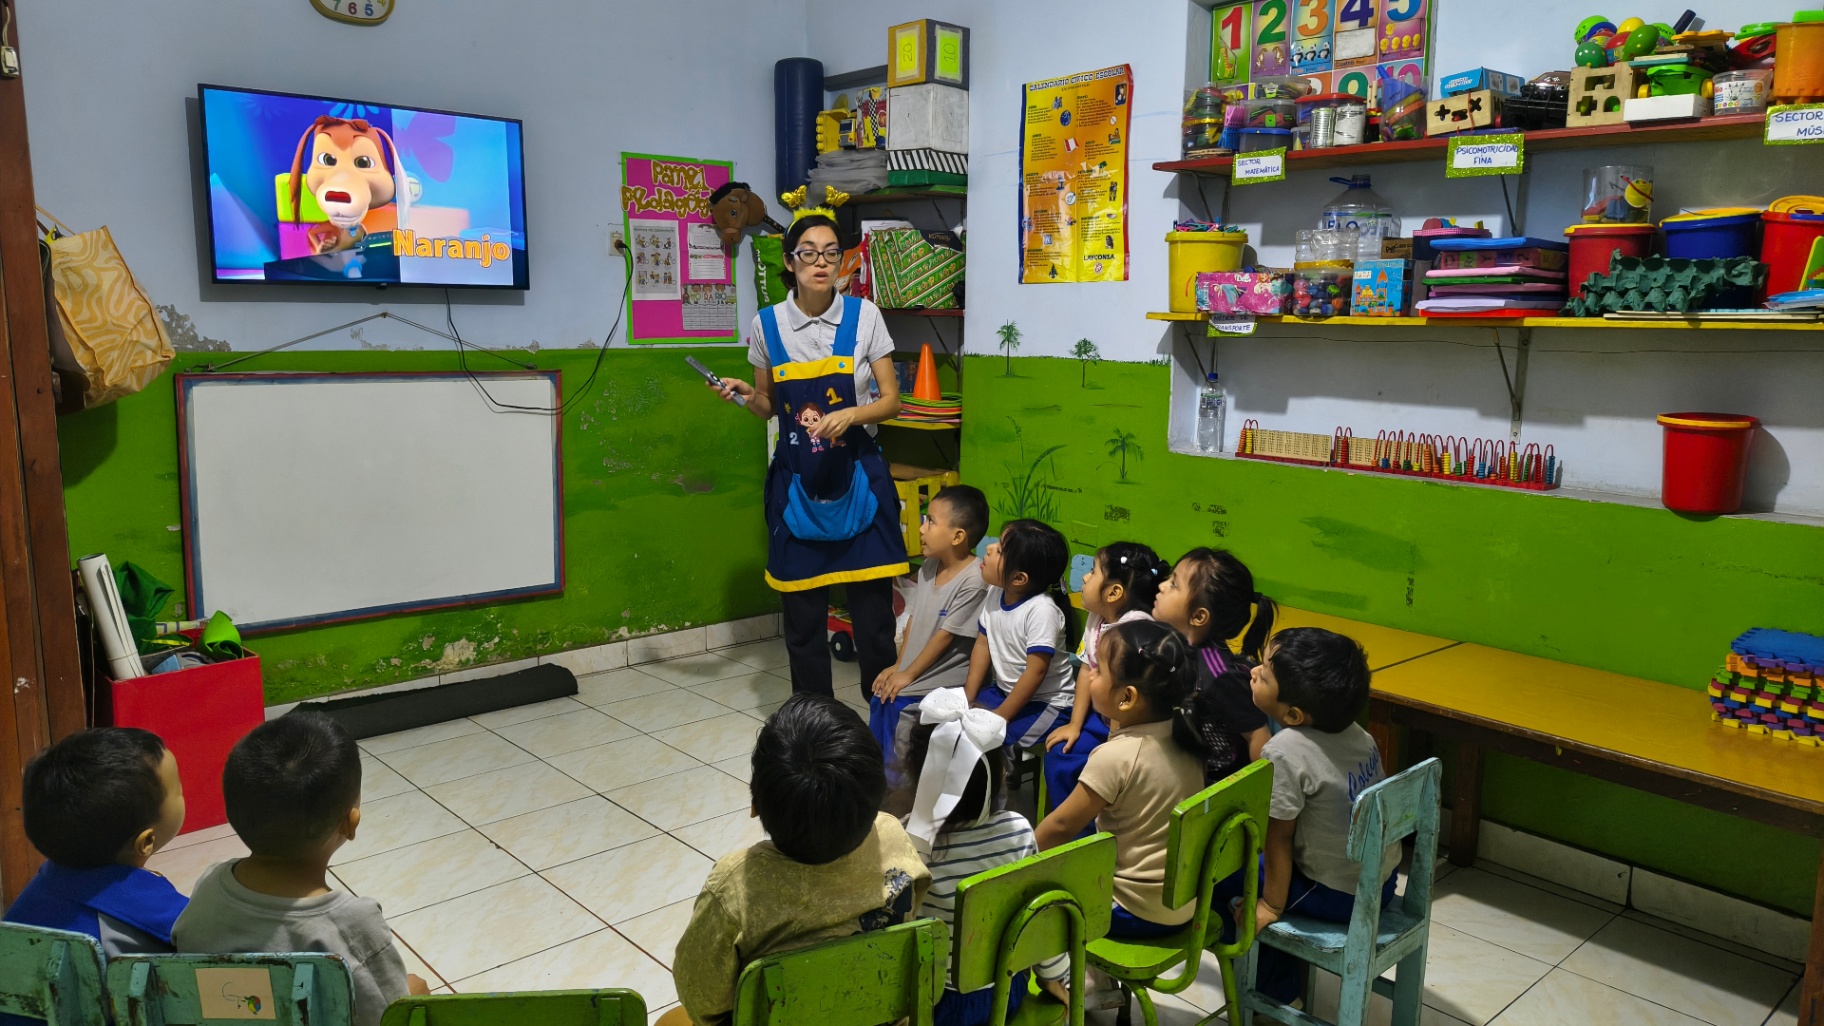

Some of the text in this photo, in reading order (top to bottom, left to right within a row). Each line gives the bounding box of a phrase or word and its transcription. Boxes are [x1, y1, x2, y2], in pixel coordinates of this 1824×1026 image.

[348, 2, 357, 15] 6
[365, 4, 374, 16] 5
[1340, 0, 1374, 28] 4
[1257, 0, 1287, 45] 2
[1297, 0, 1329, 36] 3
[1221, 7, 1243, 50] 1
[903, 43, 913, 62] 20
[943, 43, 957, 63] 10
[1029, 78, 1070, 92] CALENDARIO
[1095, 66, 1125, 80] ESCOLAR
[1772, 110, 1824, 123] SECTOR
[1796, 124, 1824, 137] MÚS
[1456, 143, 1519, 155] PSICOMOTRICIDAD
[1237, 158, 1262, 167] SECTOR
[1473, 155, 1493, 165] FINA
[1244, 165, 1280, 175] MATEMÁTICA
[392, 228, 511, 268] Naranjo
[1084, 253, 1115, 261] LAYCONSA
[826, 387, 843, 405] 1
[789, 432, 799, 445] 2
